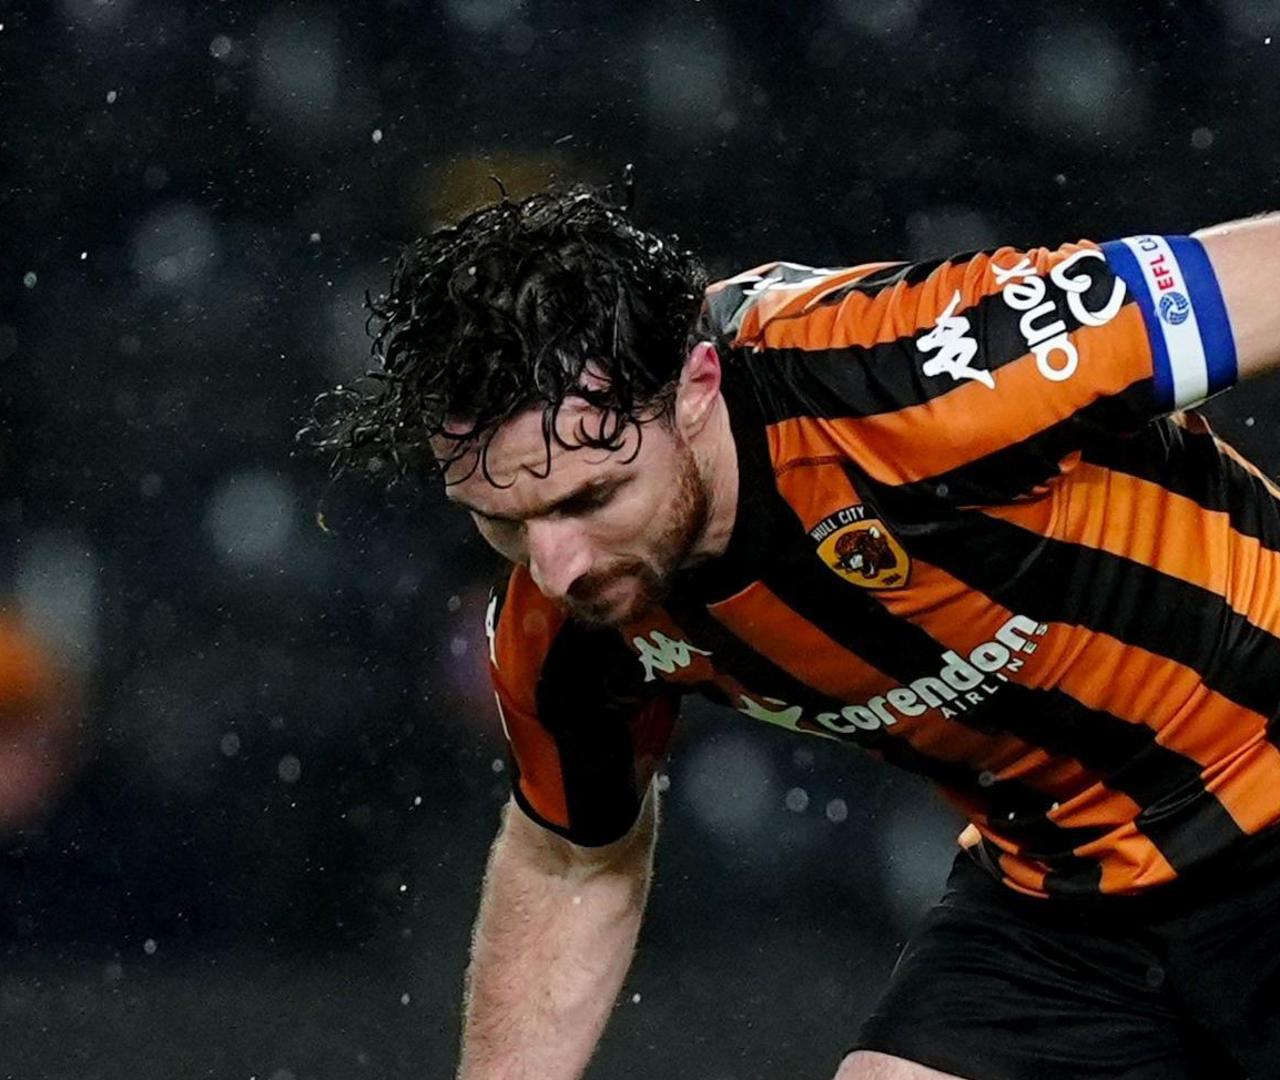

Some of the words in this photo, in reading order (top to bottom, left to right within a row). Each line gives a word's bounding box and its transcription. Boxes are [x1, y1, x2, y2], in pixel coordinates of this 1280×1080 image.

[991, 258, 1079, 382] onex
[1150, 254, 1174, 290] EFL
[810, 518, 838, 541] HULL
[838, 506, 864, 524] CITY
[816, 615, 1039, 734] corendon
[940, 623, 1049, 720] AIRLINES
